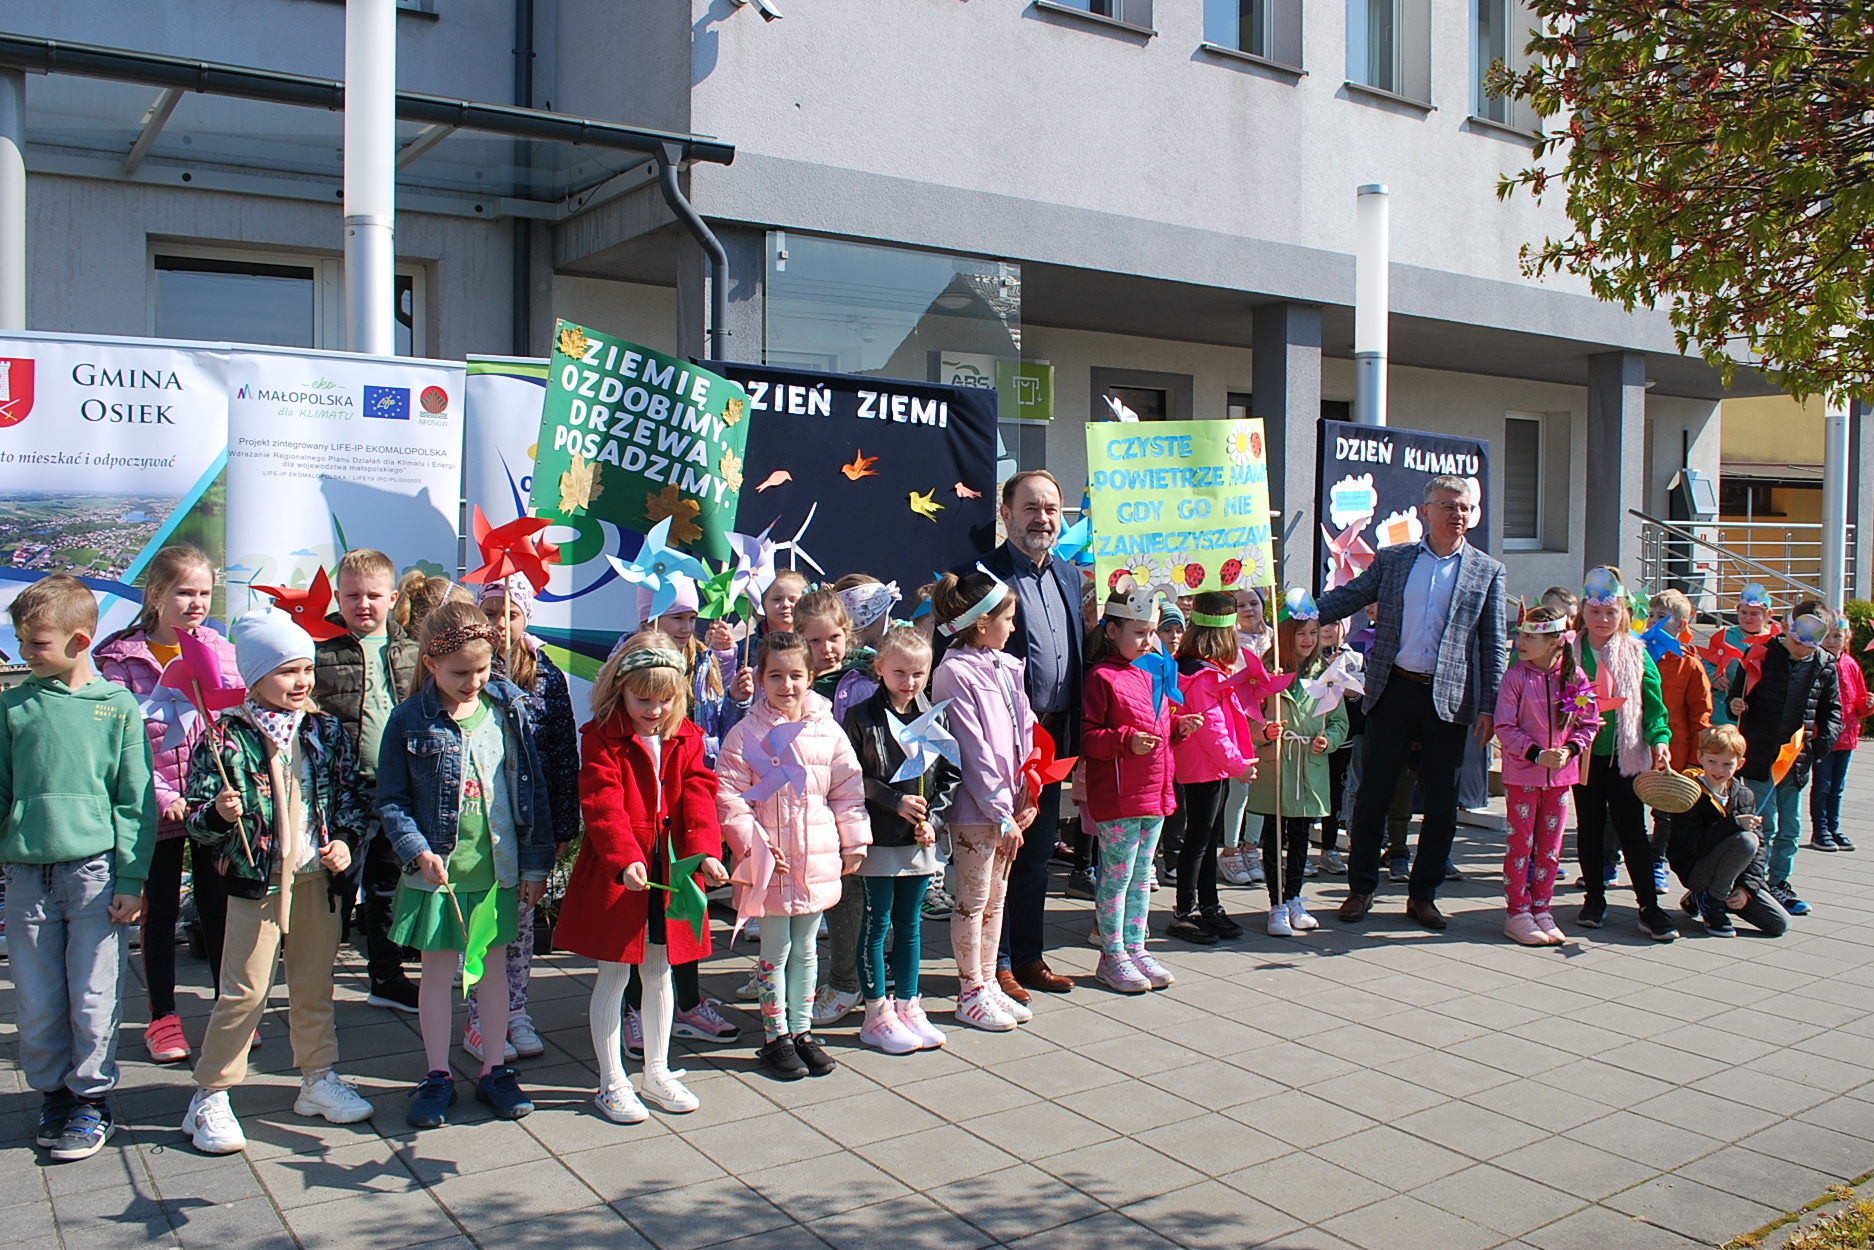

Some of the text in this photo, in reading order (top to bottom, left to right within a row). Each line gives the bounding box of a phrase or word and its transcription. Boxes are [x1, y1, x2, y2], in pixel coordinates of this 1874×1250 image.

[581, 338, 711, 411] ZIEMIĘ
[258, 389, 354, 407] MAŁOPOLSKA
[561, 364, 728, 451] OZDOBIMY,
[729, 380, 948, 428] ZIEŃ ZIEMI
[300, 408, 354, 421] KLIMATU
[239, 437, 448, 457] Projekt zintegrowany LIFE-IP EKOMALOPOLSKA
[569, 398, 709, 468] DRZEWA
[18, 452, 83, 465] mieszkać
[85, 453, 91, 465] i
[93, 453, 177, 471] odpoczywać
[1107, 435, 1193, 461] CZYSTE
[1335, 436, 1479, 475] DZIEŃ KLIMATU
[1093, 464, 1268, 492] POWIETRZE MAM
[1117, 495, 1253, 524] GDY GO NIE
